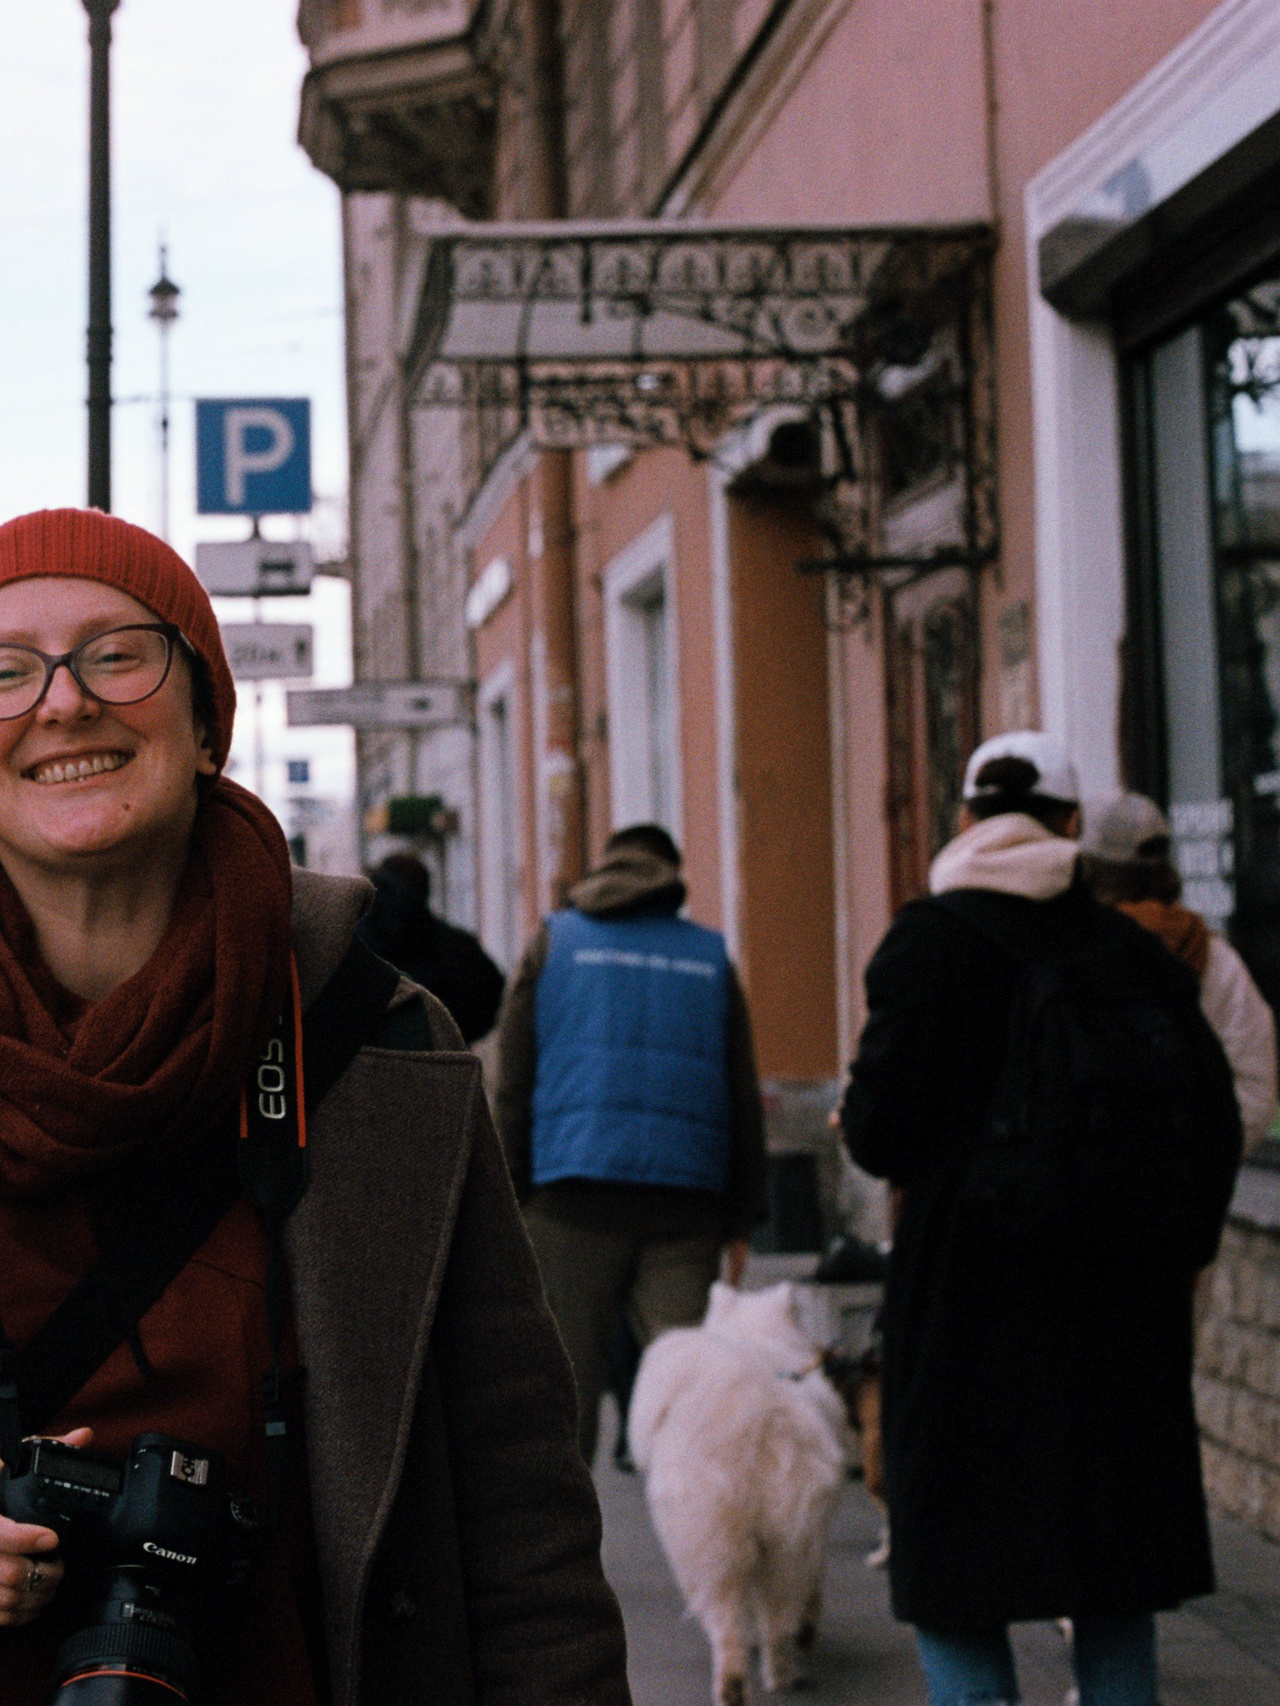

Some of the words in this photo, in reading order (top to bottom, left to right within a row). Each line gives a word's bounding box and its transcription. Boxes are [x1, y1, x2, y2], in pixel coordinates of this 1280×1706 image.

[223, 407, 295, 506] P
[257, 1038, 287, 1120] EOS
[142, 1541, 198, 1565] Canon
